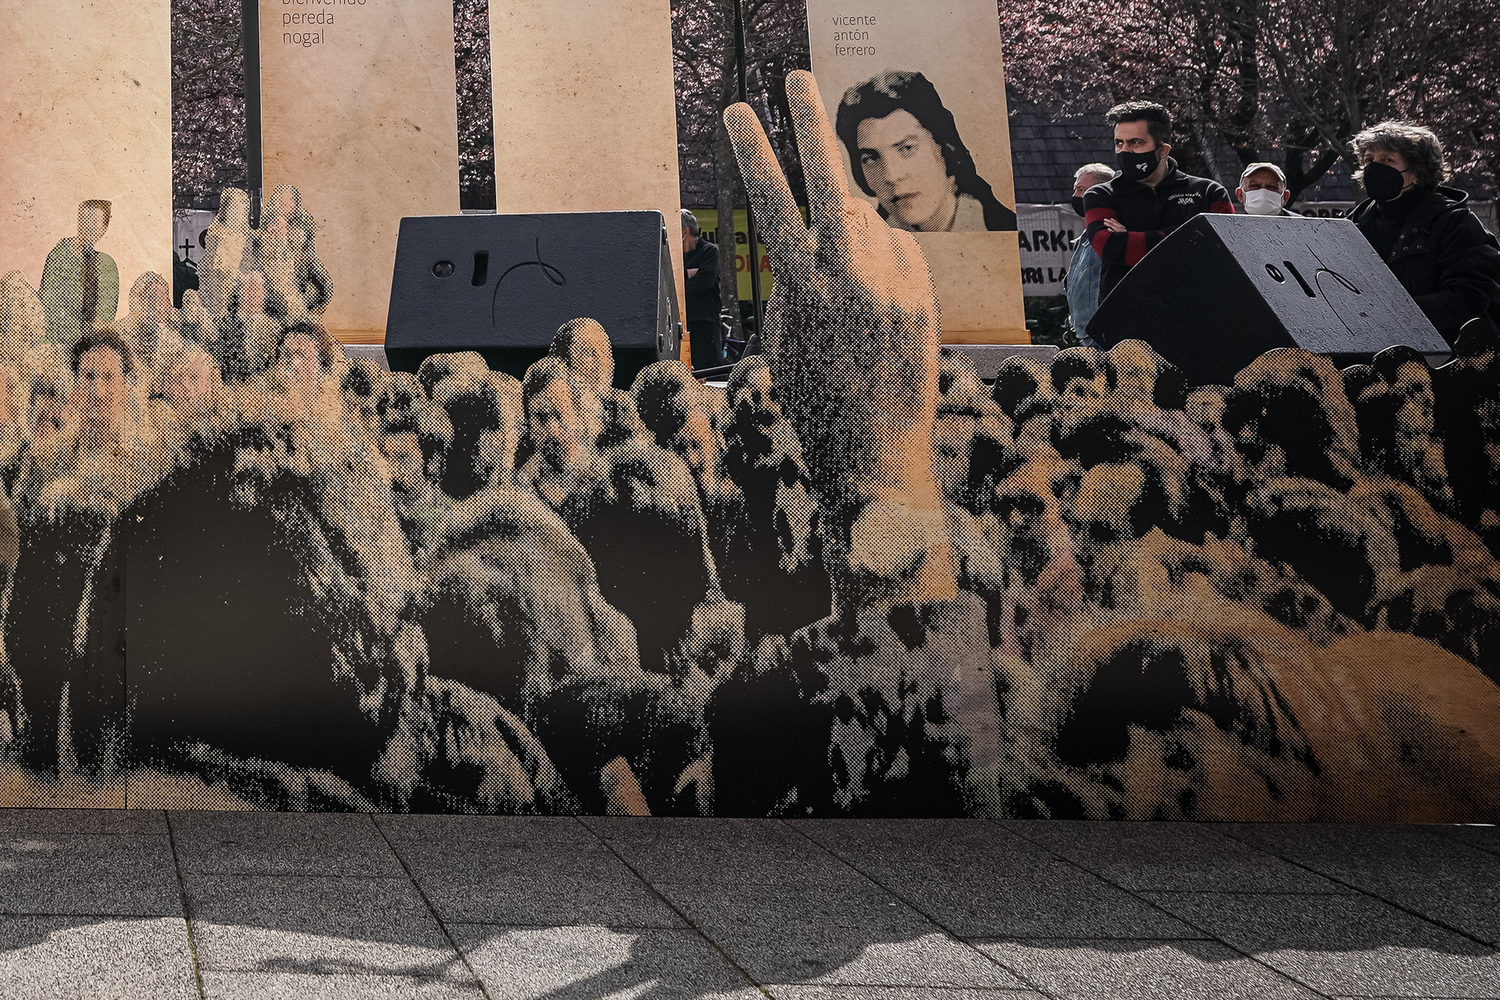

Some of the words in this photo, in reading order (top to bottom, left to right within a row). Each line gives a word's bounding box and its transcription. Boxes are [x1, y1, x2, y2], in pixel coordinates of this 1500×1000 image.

[282, 9, 335, 27] pereda
[832, 14, 877, 26] vicente
[283, 28, 325, 48] nogal
[833, 29, 869, 41] antón
[835, 43, 876, 56] ferrero
